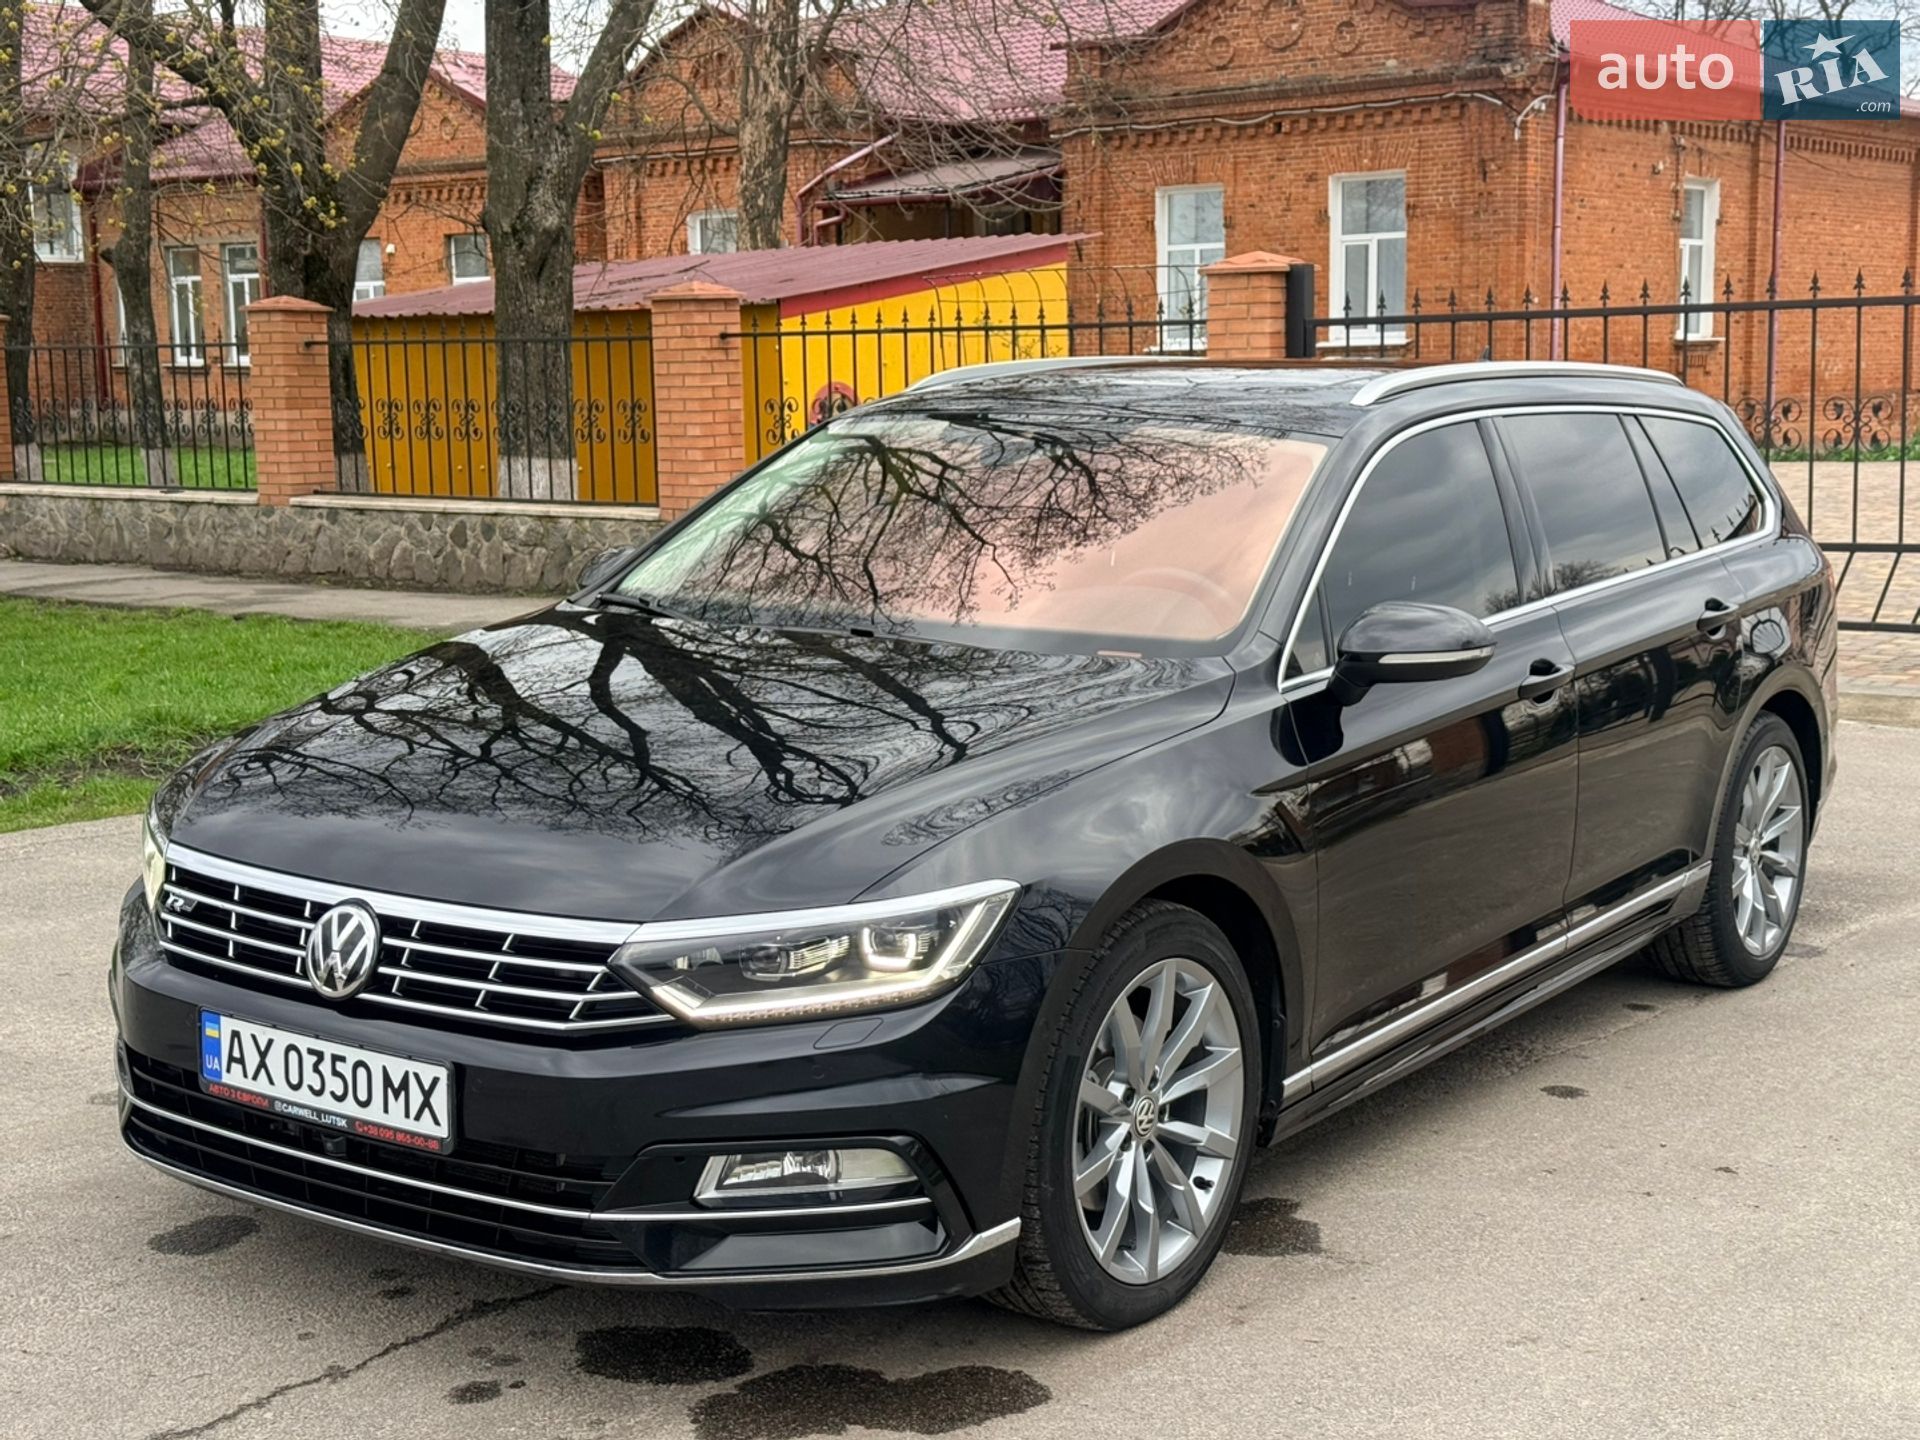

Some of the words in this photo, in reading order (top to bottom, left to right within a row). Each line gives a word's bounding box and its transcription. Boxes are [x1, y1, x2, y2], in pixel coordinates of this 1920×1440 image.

[206, 1055, 220, 1071] UA
[226, 1029, 275, 1086] AX
[284, 1043, 373, 1109] 0350
[382, 1064, 441, 1127] MX
